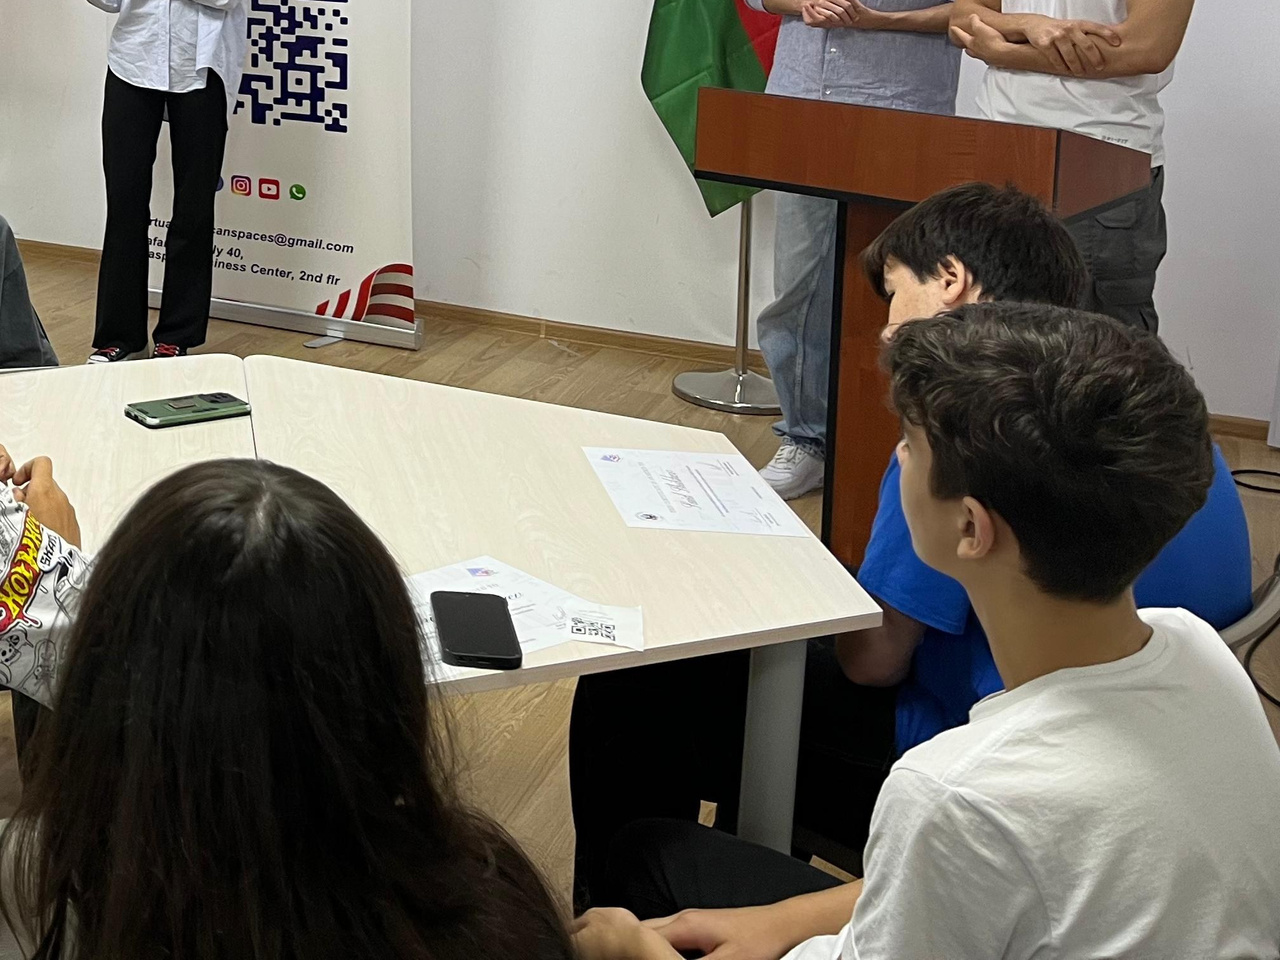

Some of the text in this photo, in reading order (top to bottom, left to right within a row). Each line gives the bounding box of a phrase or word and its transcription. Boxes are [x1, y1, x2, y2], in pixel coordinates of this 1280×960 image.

[226, 246, 244, 260] 40,
[213, 258, 341, 286] iness Center, 2nd flr
